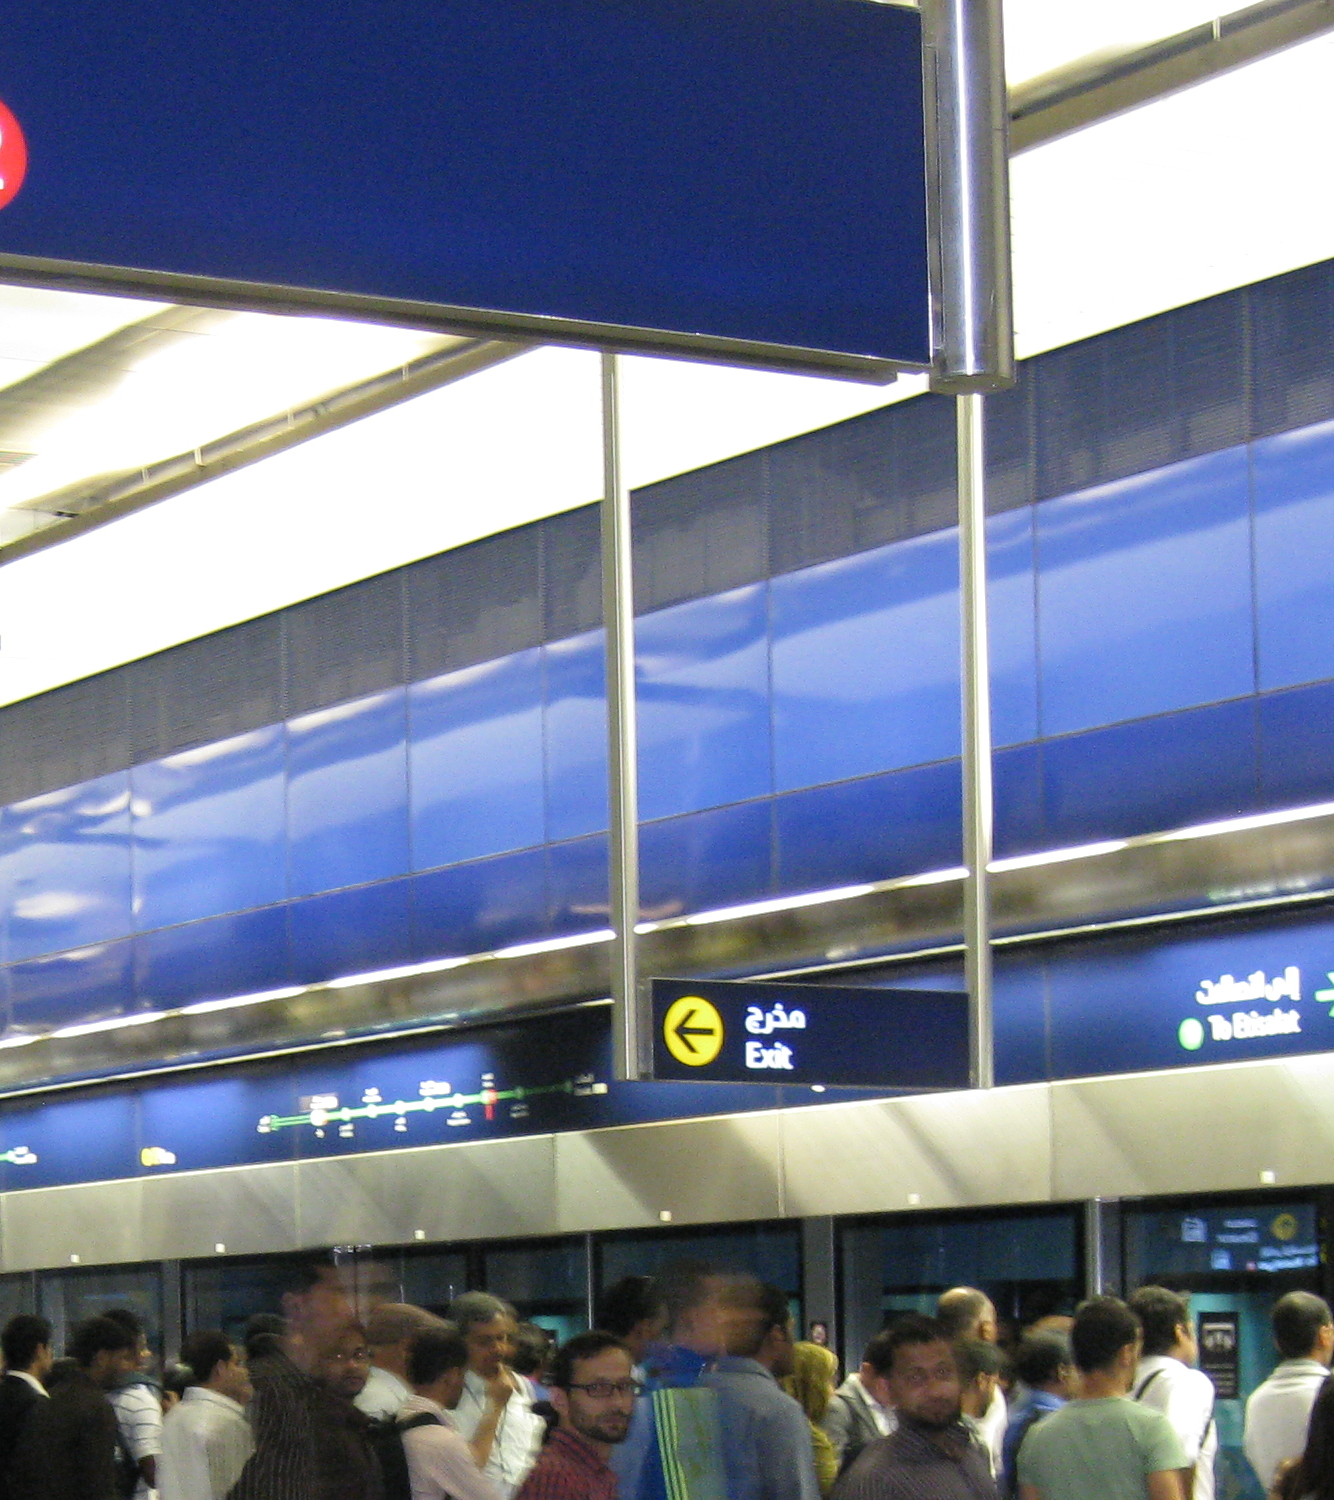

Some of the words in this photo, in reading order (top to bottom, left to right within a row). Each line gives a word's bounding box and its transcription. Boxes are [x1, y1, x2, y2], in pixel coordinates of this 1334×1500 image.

[745, 1003, 806, 1035] مخرج
[1208, 1014, 1233, 1041] To
[745, 1041, 794, 1070] Exit
